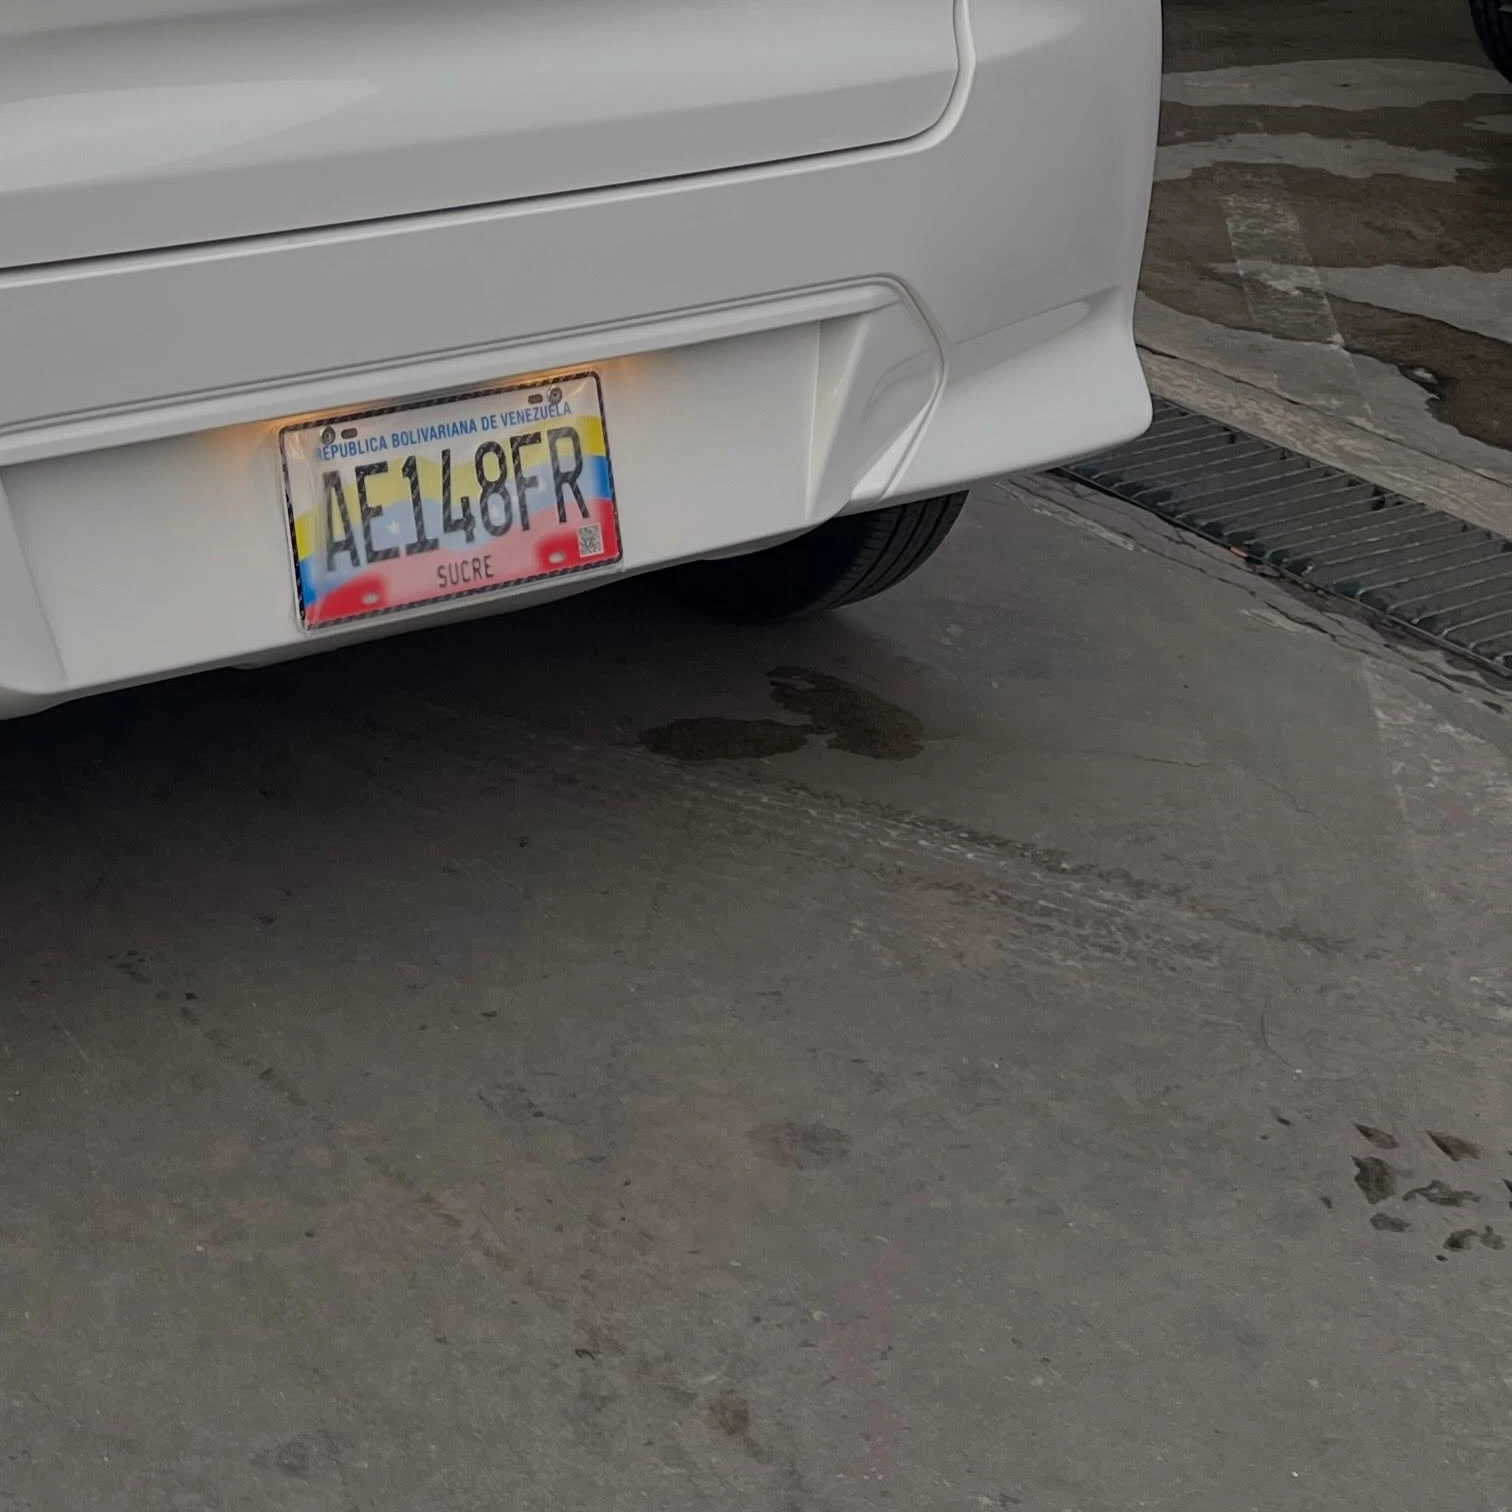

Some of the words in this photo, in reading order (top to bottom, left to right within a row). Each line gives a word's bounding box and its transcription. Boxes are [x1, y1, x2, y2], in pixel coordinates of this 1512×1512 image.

[391, 418, 477, 449] BOLIVARIANA
[481, 414, 497, 431] DE
[501, 400, 572, 427] VENEZUELA
[322, 426, 591, 573] AE148FR
[437, 554, 494, 588] SUCRE
